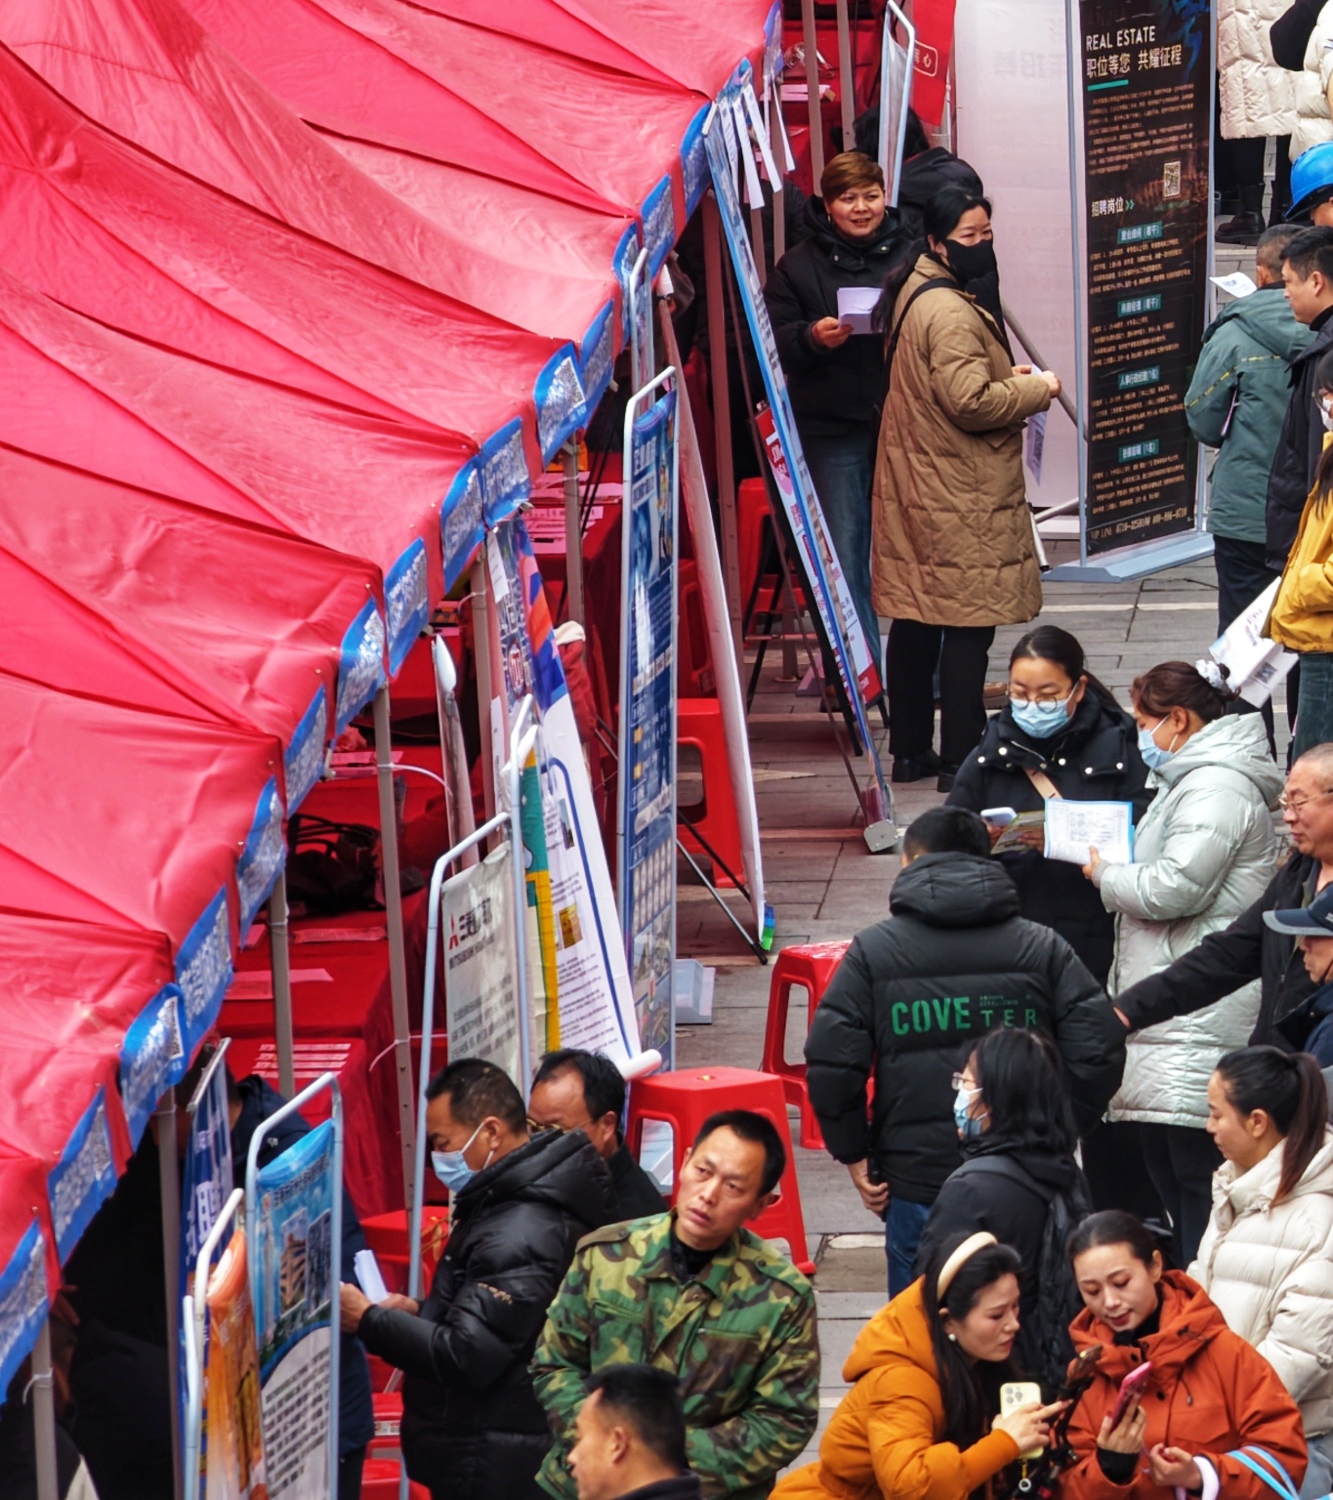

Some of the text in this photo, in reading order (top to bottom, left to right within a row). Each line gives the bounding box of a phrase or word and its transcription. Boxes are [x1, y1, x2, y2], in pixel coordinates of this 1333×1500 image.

[1086, 25, 1157, 52] REAL ESTATE
[890, 995, 972, 1037] COVE
